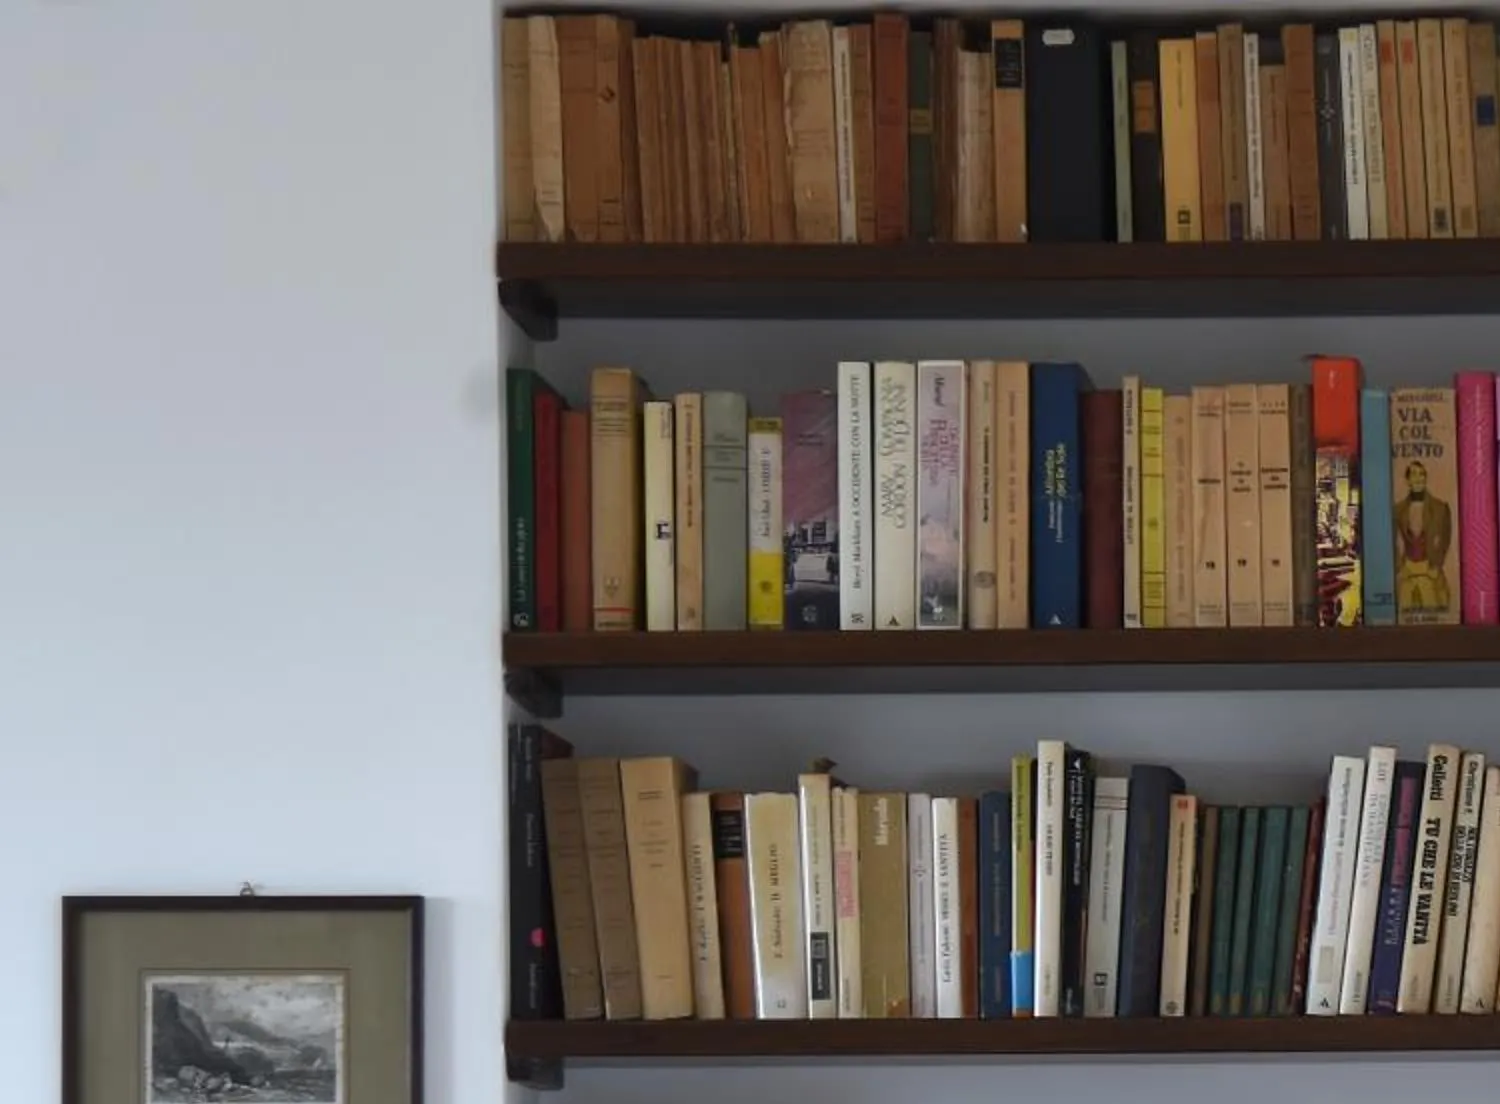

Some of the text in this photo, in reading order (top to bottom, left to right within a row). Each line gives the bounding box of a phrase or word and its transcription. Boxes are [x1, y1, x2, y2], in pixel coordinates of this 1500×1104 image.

[1397, 407, 1433, 423] VIA
[1399, 424, 1432, 440] COL
[1392, 443, 1444, 458] VENTO
[881, 474, 893, 515] MARY
[1424, 817, 1441, 836] TU
[1421, 838, 1439, 869] CHE
[1418, 871, 1436, 890] LE
